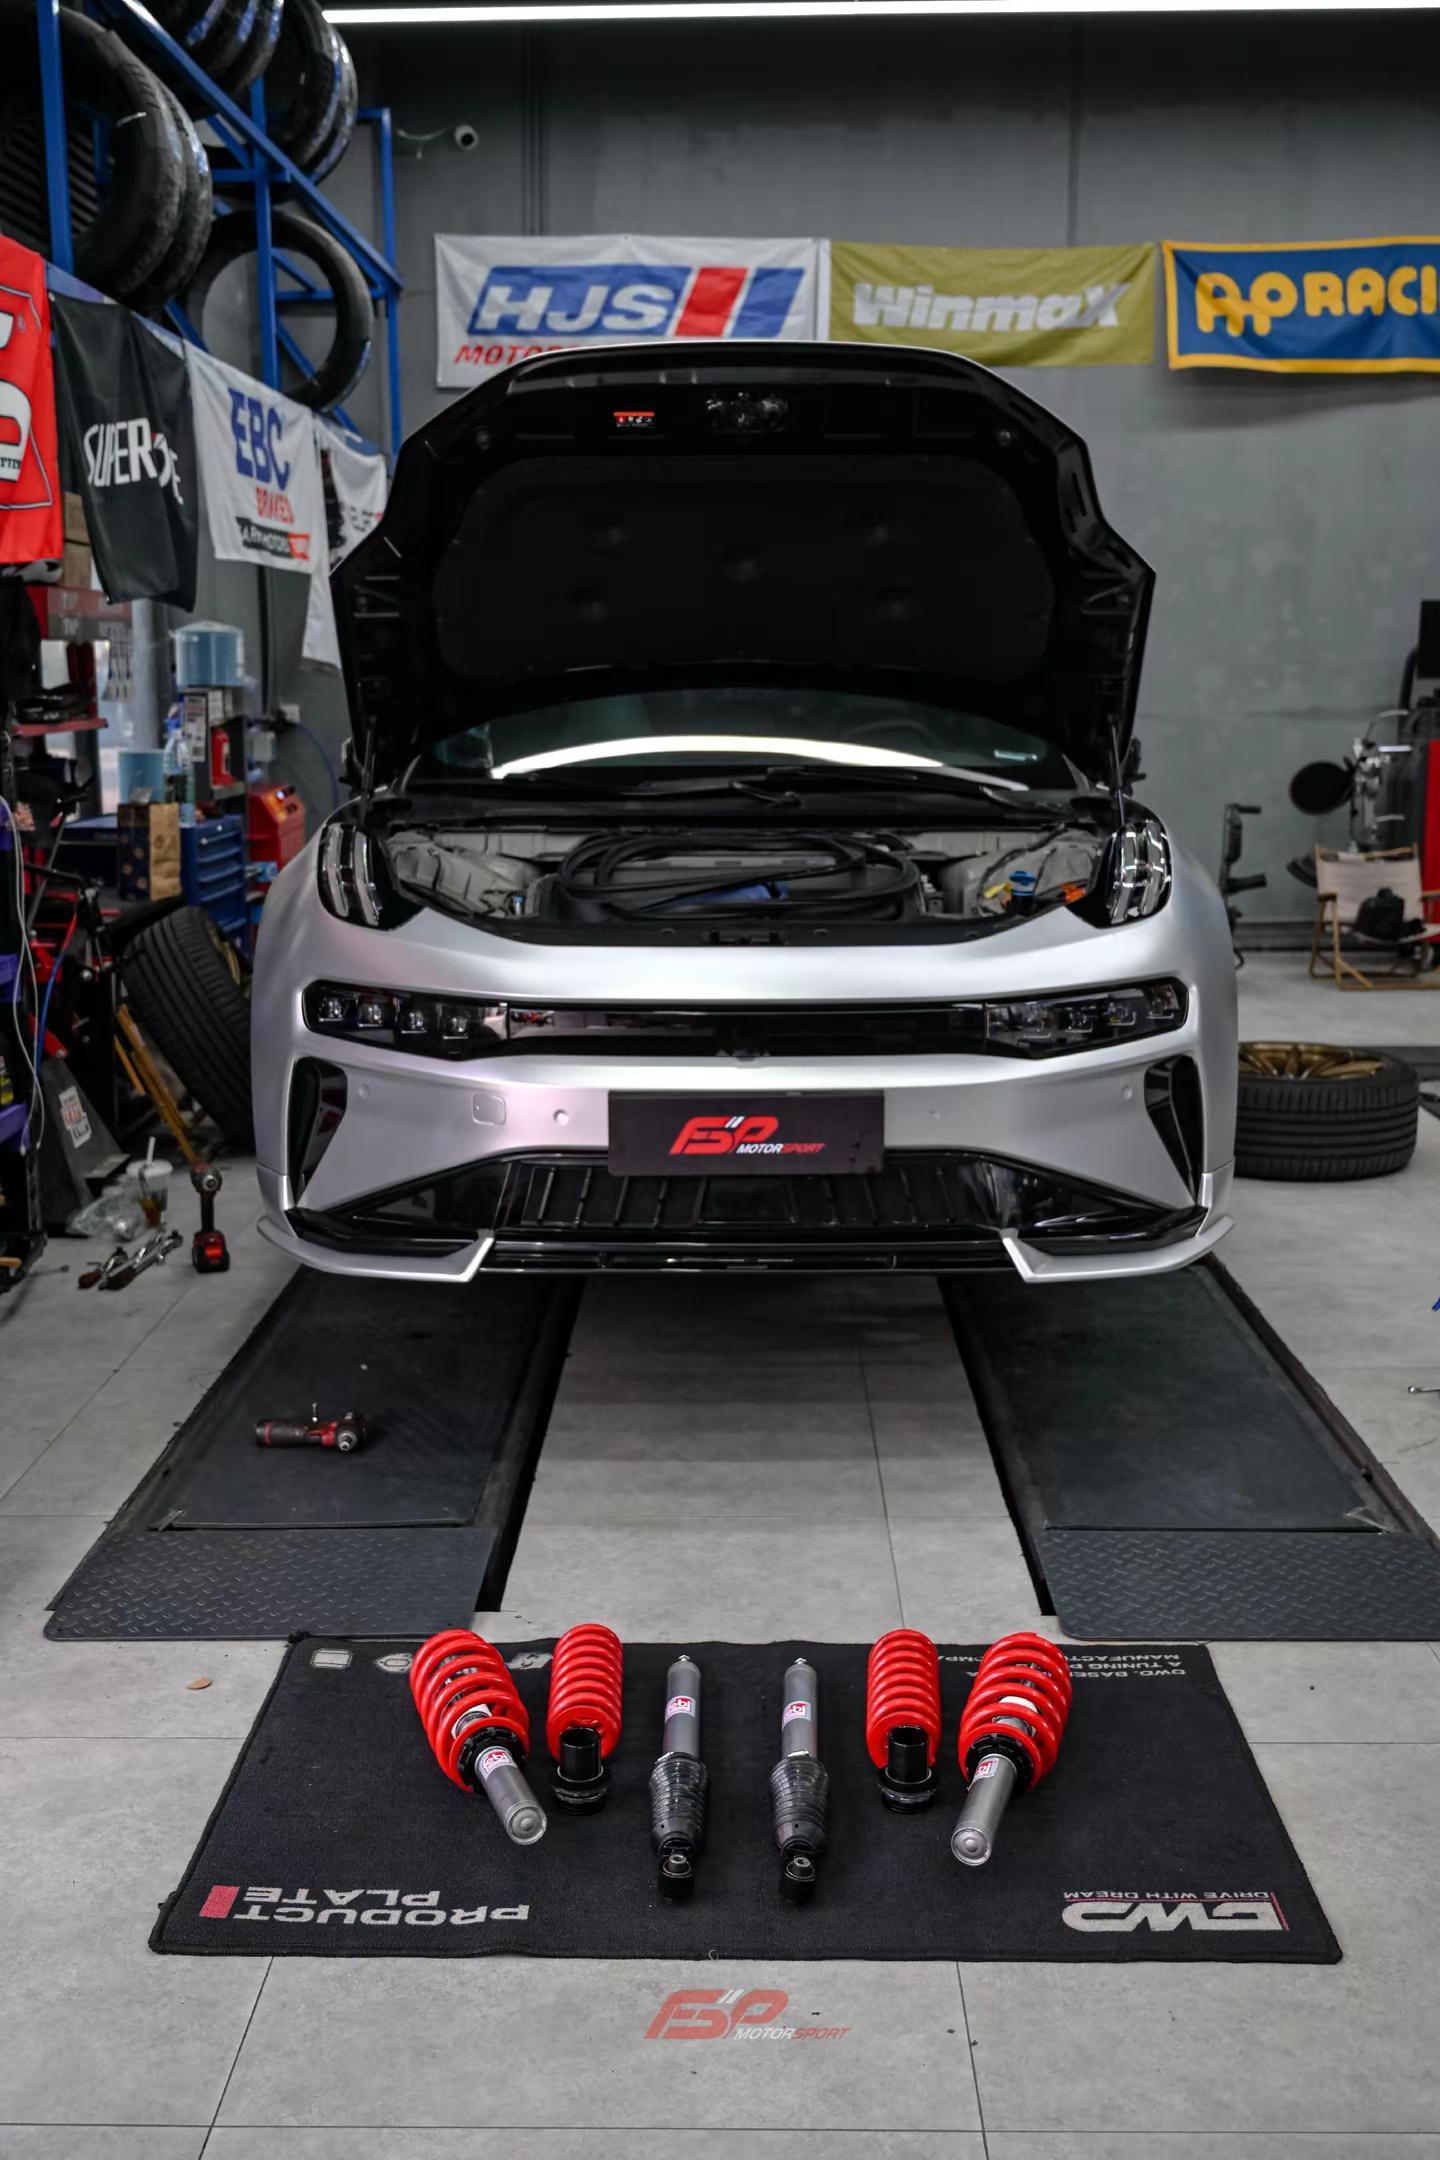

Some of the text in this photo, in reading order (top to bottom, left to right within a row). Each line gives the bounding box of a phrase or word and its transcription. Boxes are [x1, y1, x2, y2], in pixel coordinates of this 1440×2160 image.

[474, 284, 675, 332] HJS
[1196, 264, 1438, 337] AP RACI
[228, 387, 291, 491] EBC
[736, 1143, 825, 1155] MOTORSPORT
[1064, 1654, 1180, 1662] MANUFACT
[243, 1887, 440, 1906] PLATE
[1063, 1891, 1140, 1899] DREAM
[1203, 1891, 1269, 1899] DRIVE
[233, 1904, 530, 1926] PRODUCT
